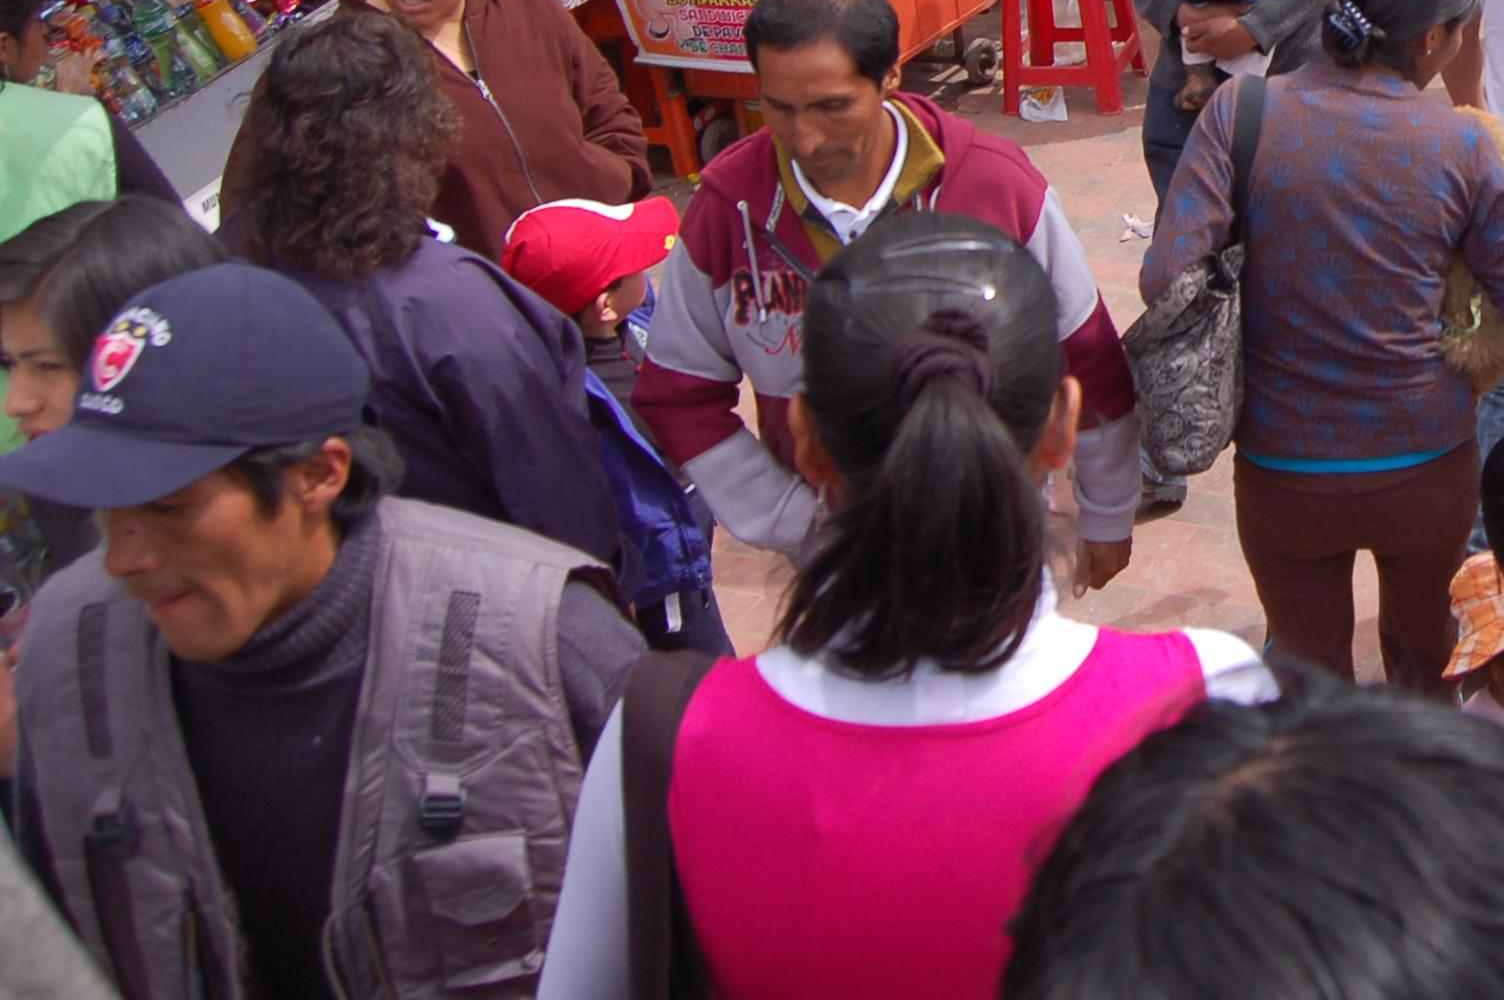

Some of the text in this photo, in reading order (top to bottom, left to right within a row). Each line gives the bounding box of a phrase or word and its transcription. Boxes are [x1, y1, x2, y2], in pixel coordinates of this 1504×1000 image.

[679, 9, 749, 23] SANDWIC
[692, 26, 744, 39] DE PAV
